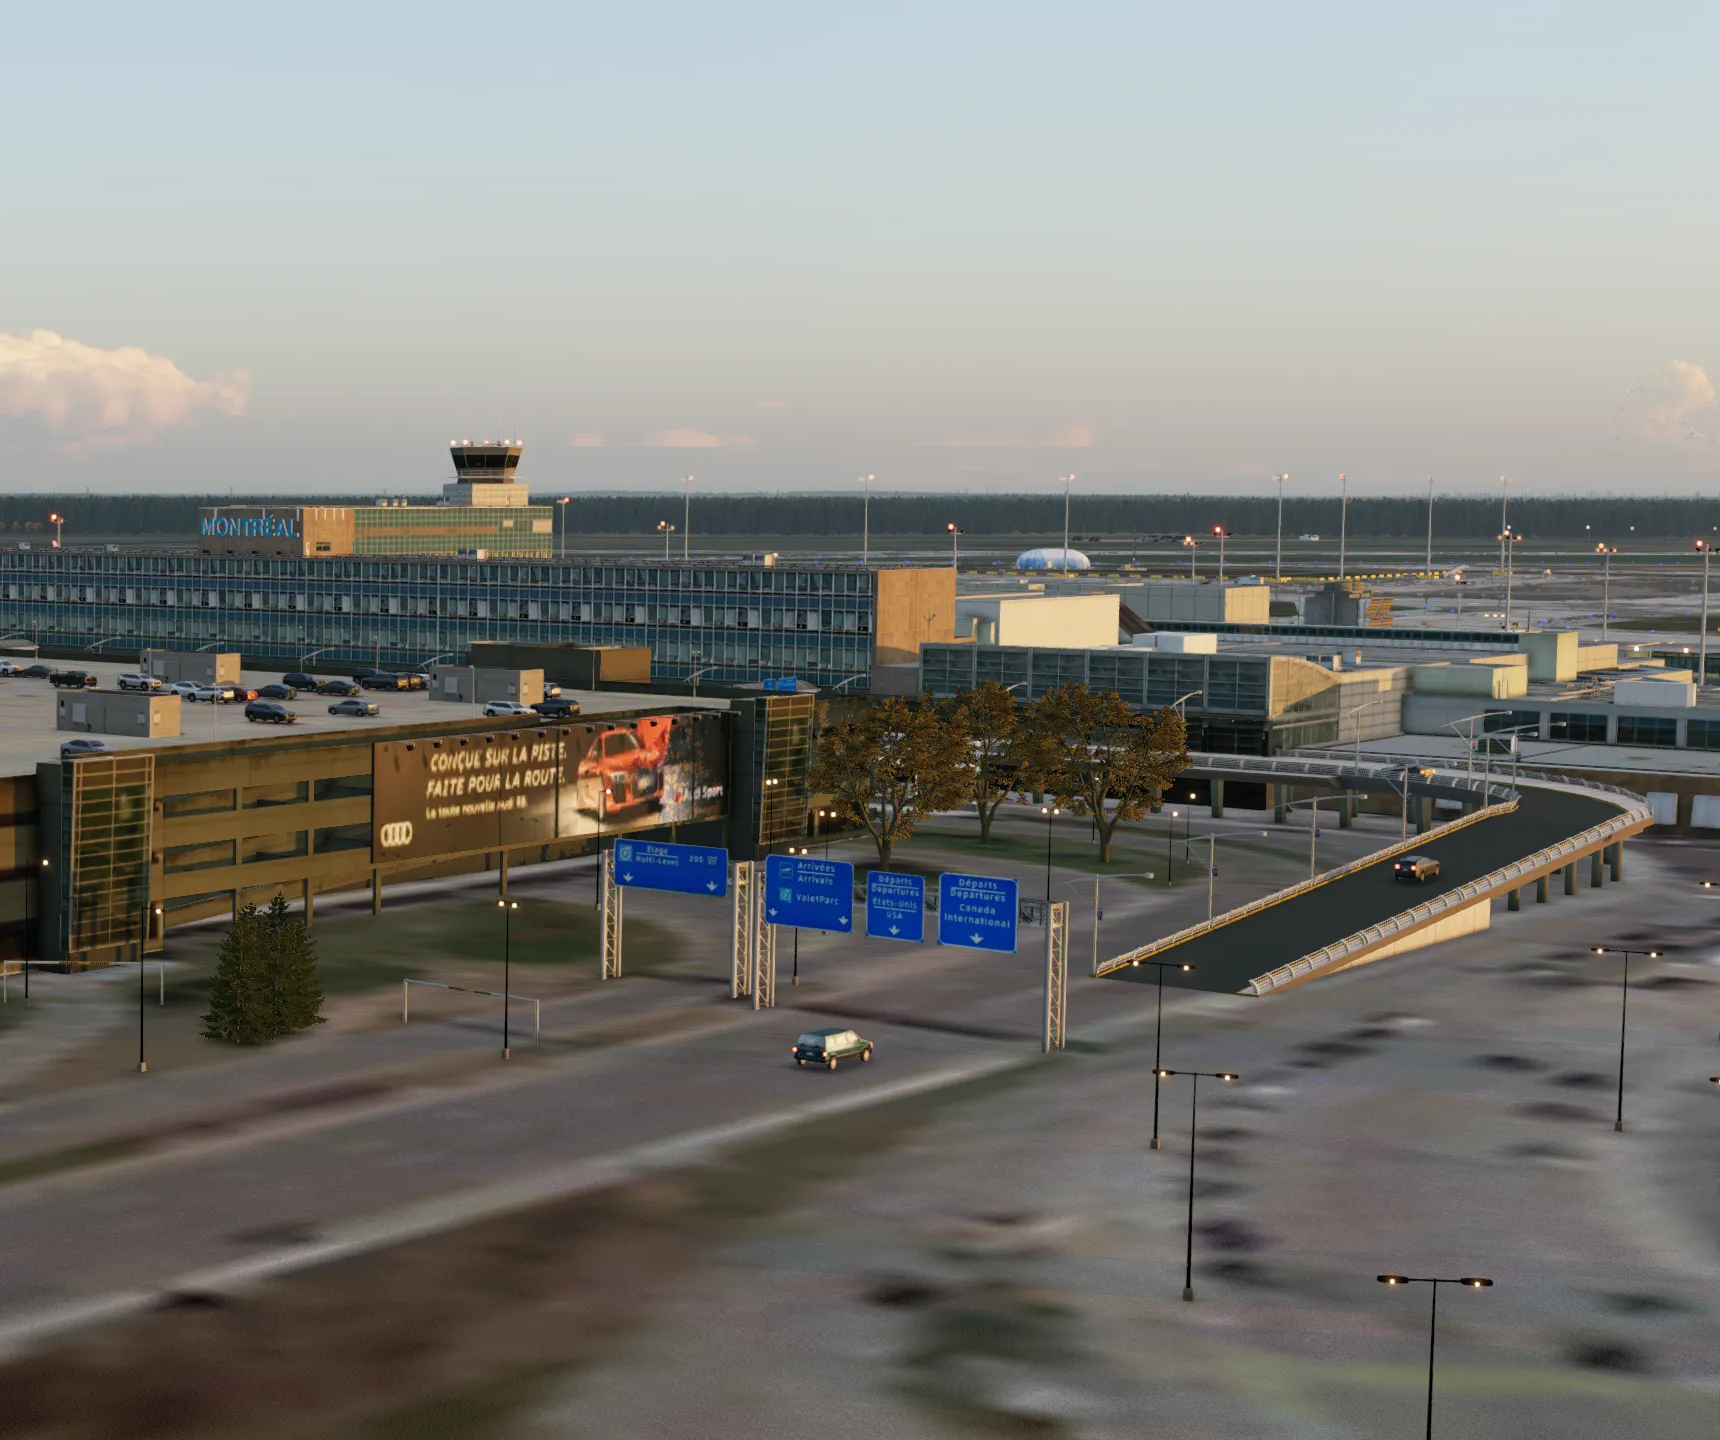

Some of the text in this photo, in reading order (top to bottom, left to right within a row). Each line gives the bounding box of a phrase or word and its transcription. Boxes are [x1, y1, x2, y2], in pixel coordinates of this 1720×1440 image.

[201, 513, 299, 537] MONTRÉAL
[484, 747, 510, 768] SUR
[512, 744, 528, 764] LA
[426, 775, 465, 799] FAITE
[467, 773, 501, 794] POUR
[505, 771, 520, 790] LA
[797, 862, 836, 873] Arrivées
[797, 875, 834, 886] Arrivals
[958, 879, 998, 890] Départs
[886, 911, 903, 919] USA
[959, 903, 996, 915] Canada
[944, 913, 1011, 929] International
